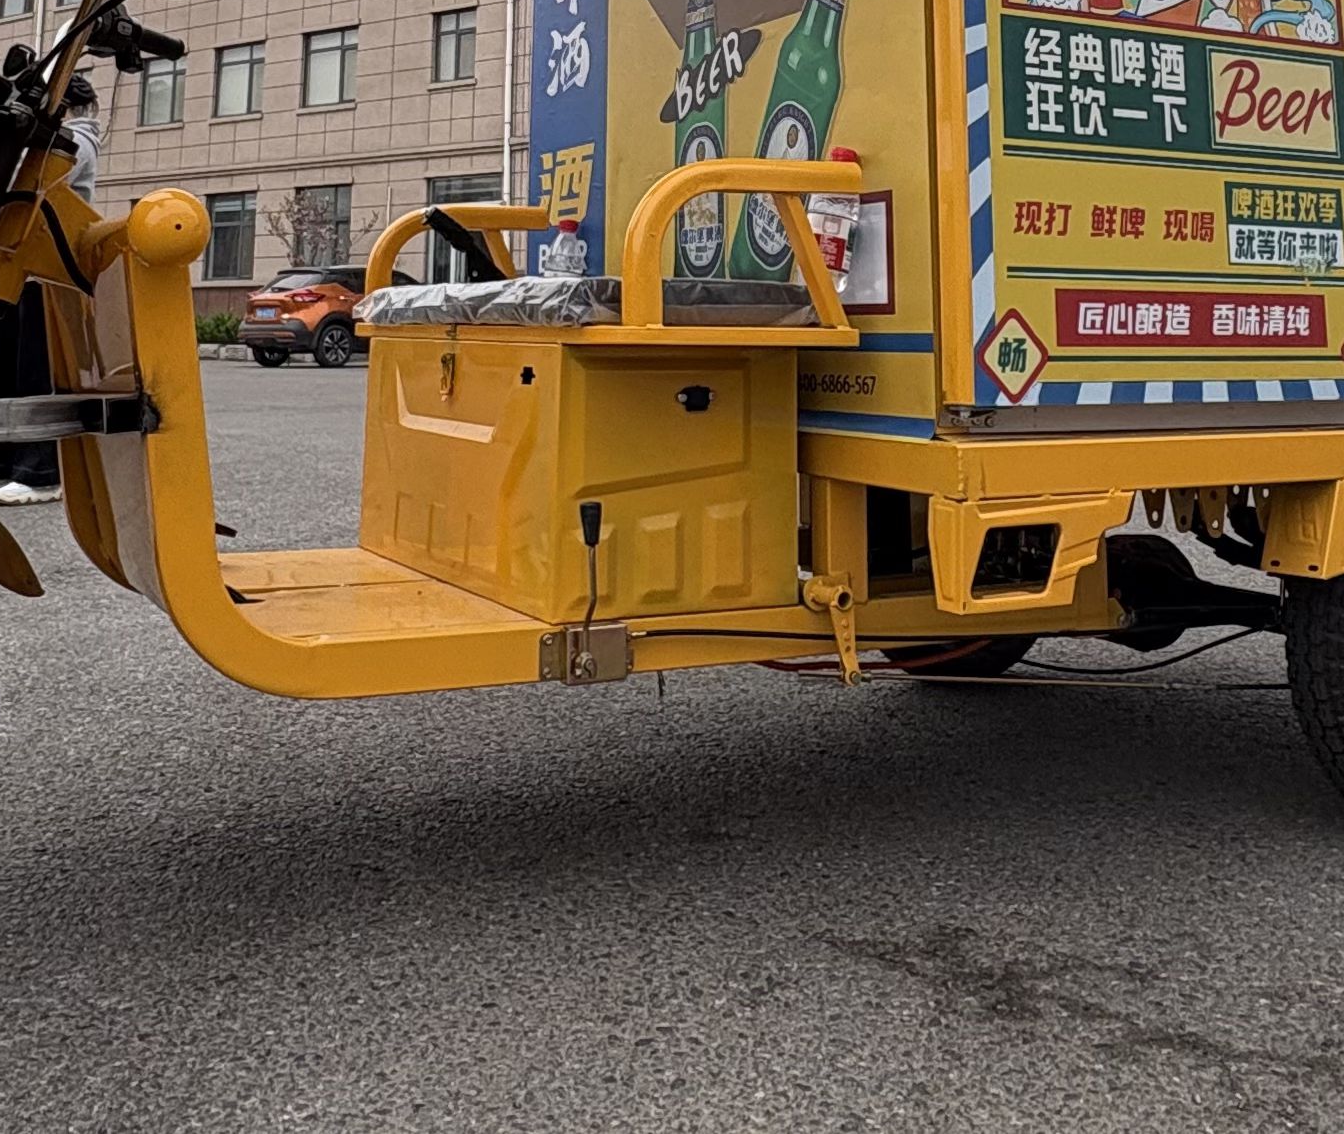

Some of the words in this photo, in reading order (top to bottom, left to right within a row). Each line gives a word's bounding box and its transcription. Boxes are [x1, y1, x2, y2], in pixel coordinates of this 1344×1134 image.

[675, 31, 743, 120] BEER
[1023, 26, 1187, 93] 经典啤酒
[1025, 81, 1188, 143] 狂饮一下
[1214, 59, 1333, 139] Beer
[1013, 201, 1072, 236] 现打
[1090, 203, 1147, 240] 鲜啤
[1162, 209, 1215, 244] 现喝
[1231, 187, 1338, 223] 啤酒狂欢季
[1234, 228, 1339, 266] 就等你来啦
[1077, 301, 1191, 337] 匠心酿造
[1212, 303, 1311, 337] 香味清纯
[997, 336, 1027, 374] 畅
